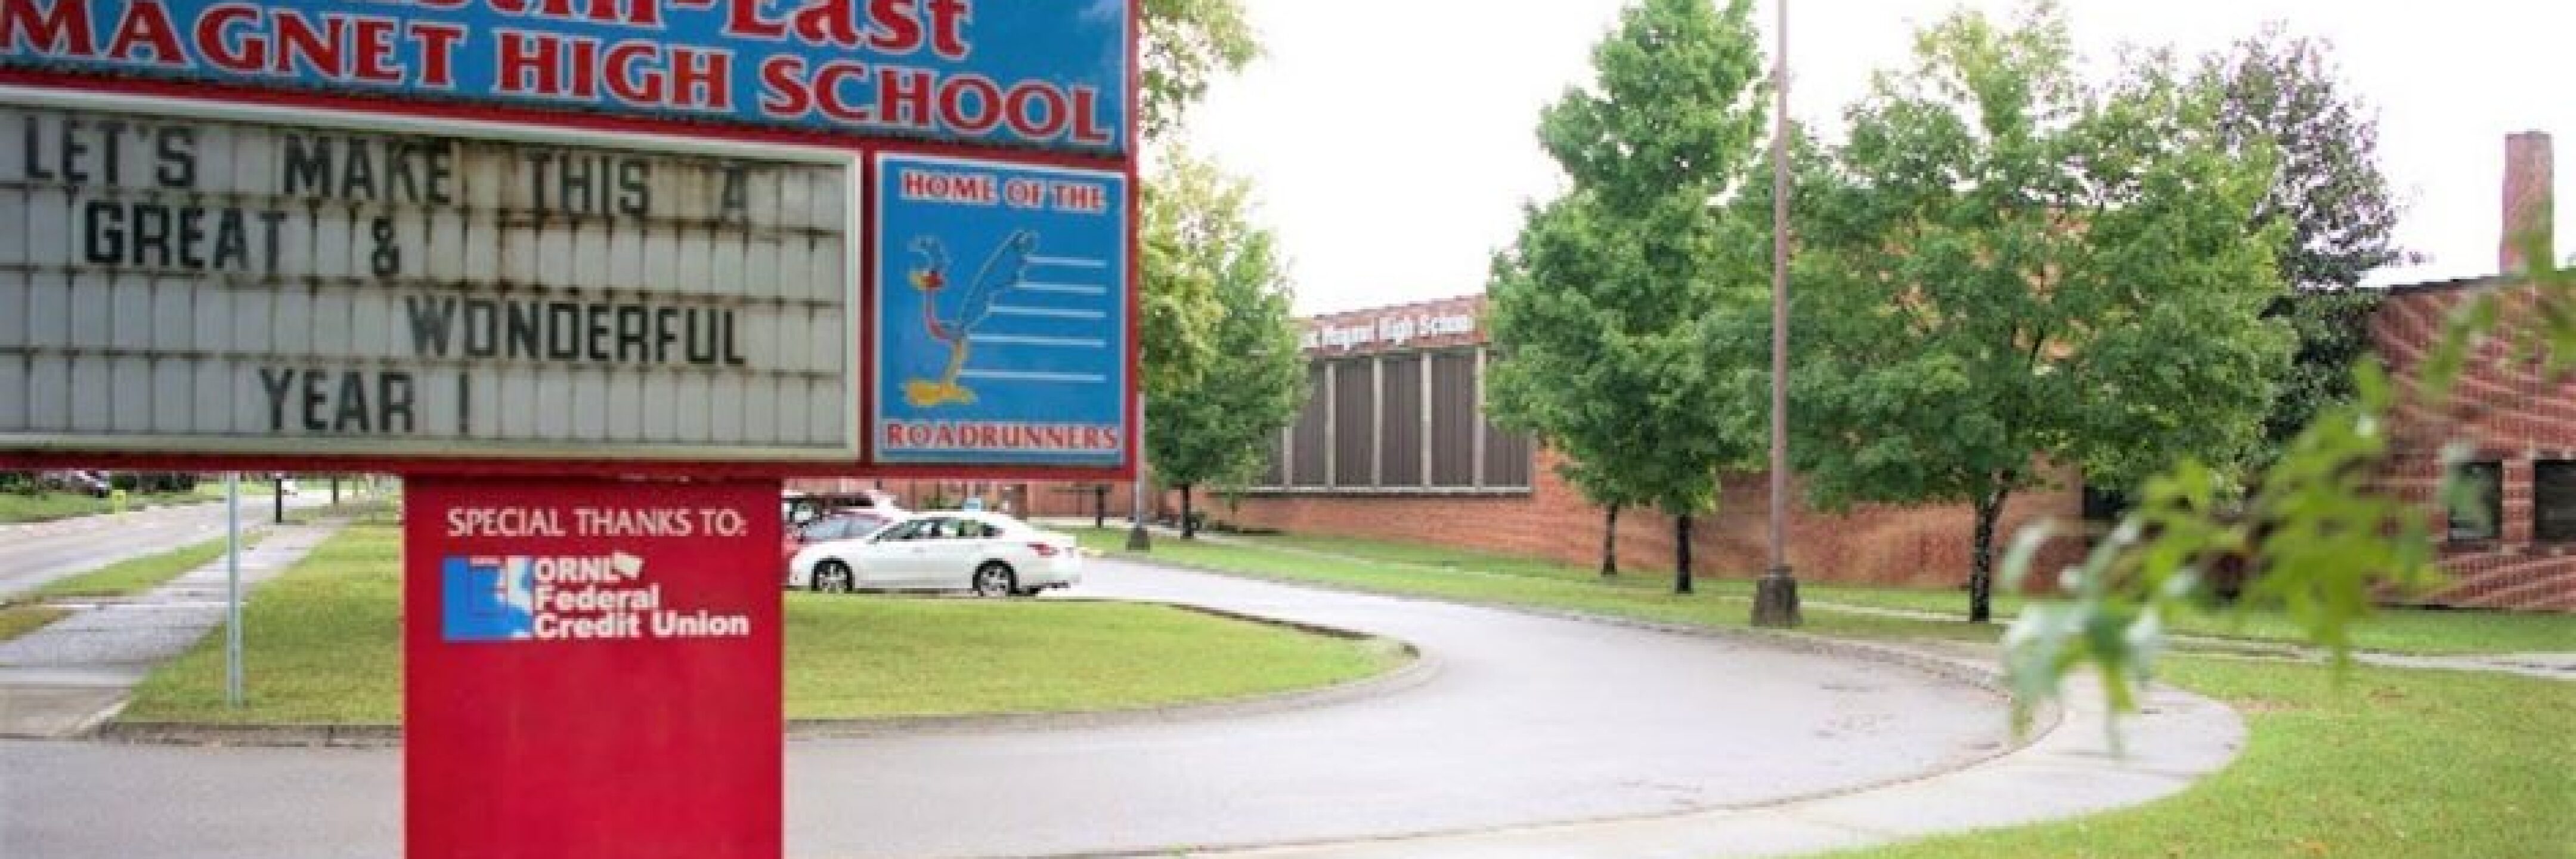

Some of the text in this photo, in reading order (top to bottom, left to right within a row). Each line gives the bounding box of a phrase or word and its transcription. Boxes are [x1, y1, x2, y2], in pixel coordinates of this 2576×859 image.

[0, 0, 1114, 146] MAGNET HIGH SCHOOL
[24, 117, 750, 223] LET'S MAKE THIS A
[902, 169, 1106, 211] HOME OF THE
[85, 198, 401, 277] GREAT &
[405, 295, 747, 365] WONDERFUL
[259, 366, 415, 433] YEAR
[885, 422, 1119, 449] ROADRUNNERS
[446, 507, 748, 538] SPECIAL THANKS TO:
[534, 555, 620, 583] ORNL
[535, 582, 660, 611] Federal
[534, 610, 750, 638] Credit Union
